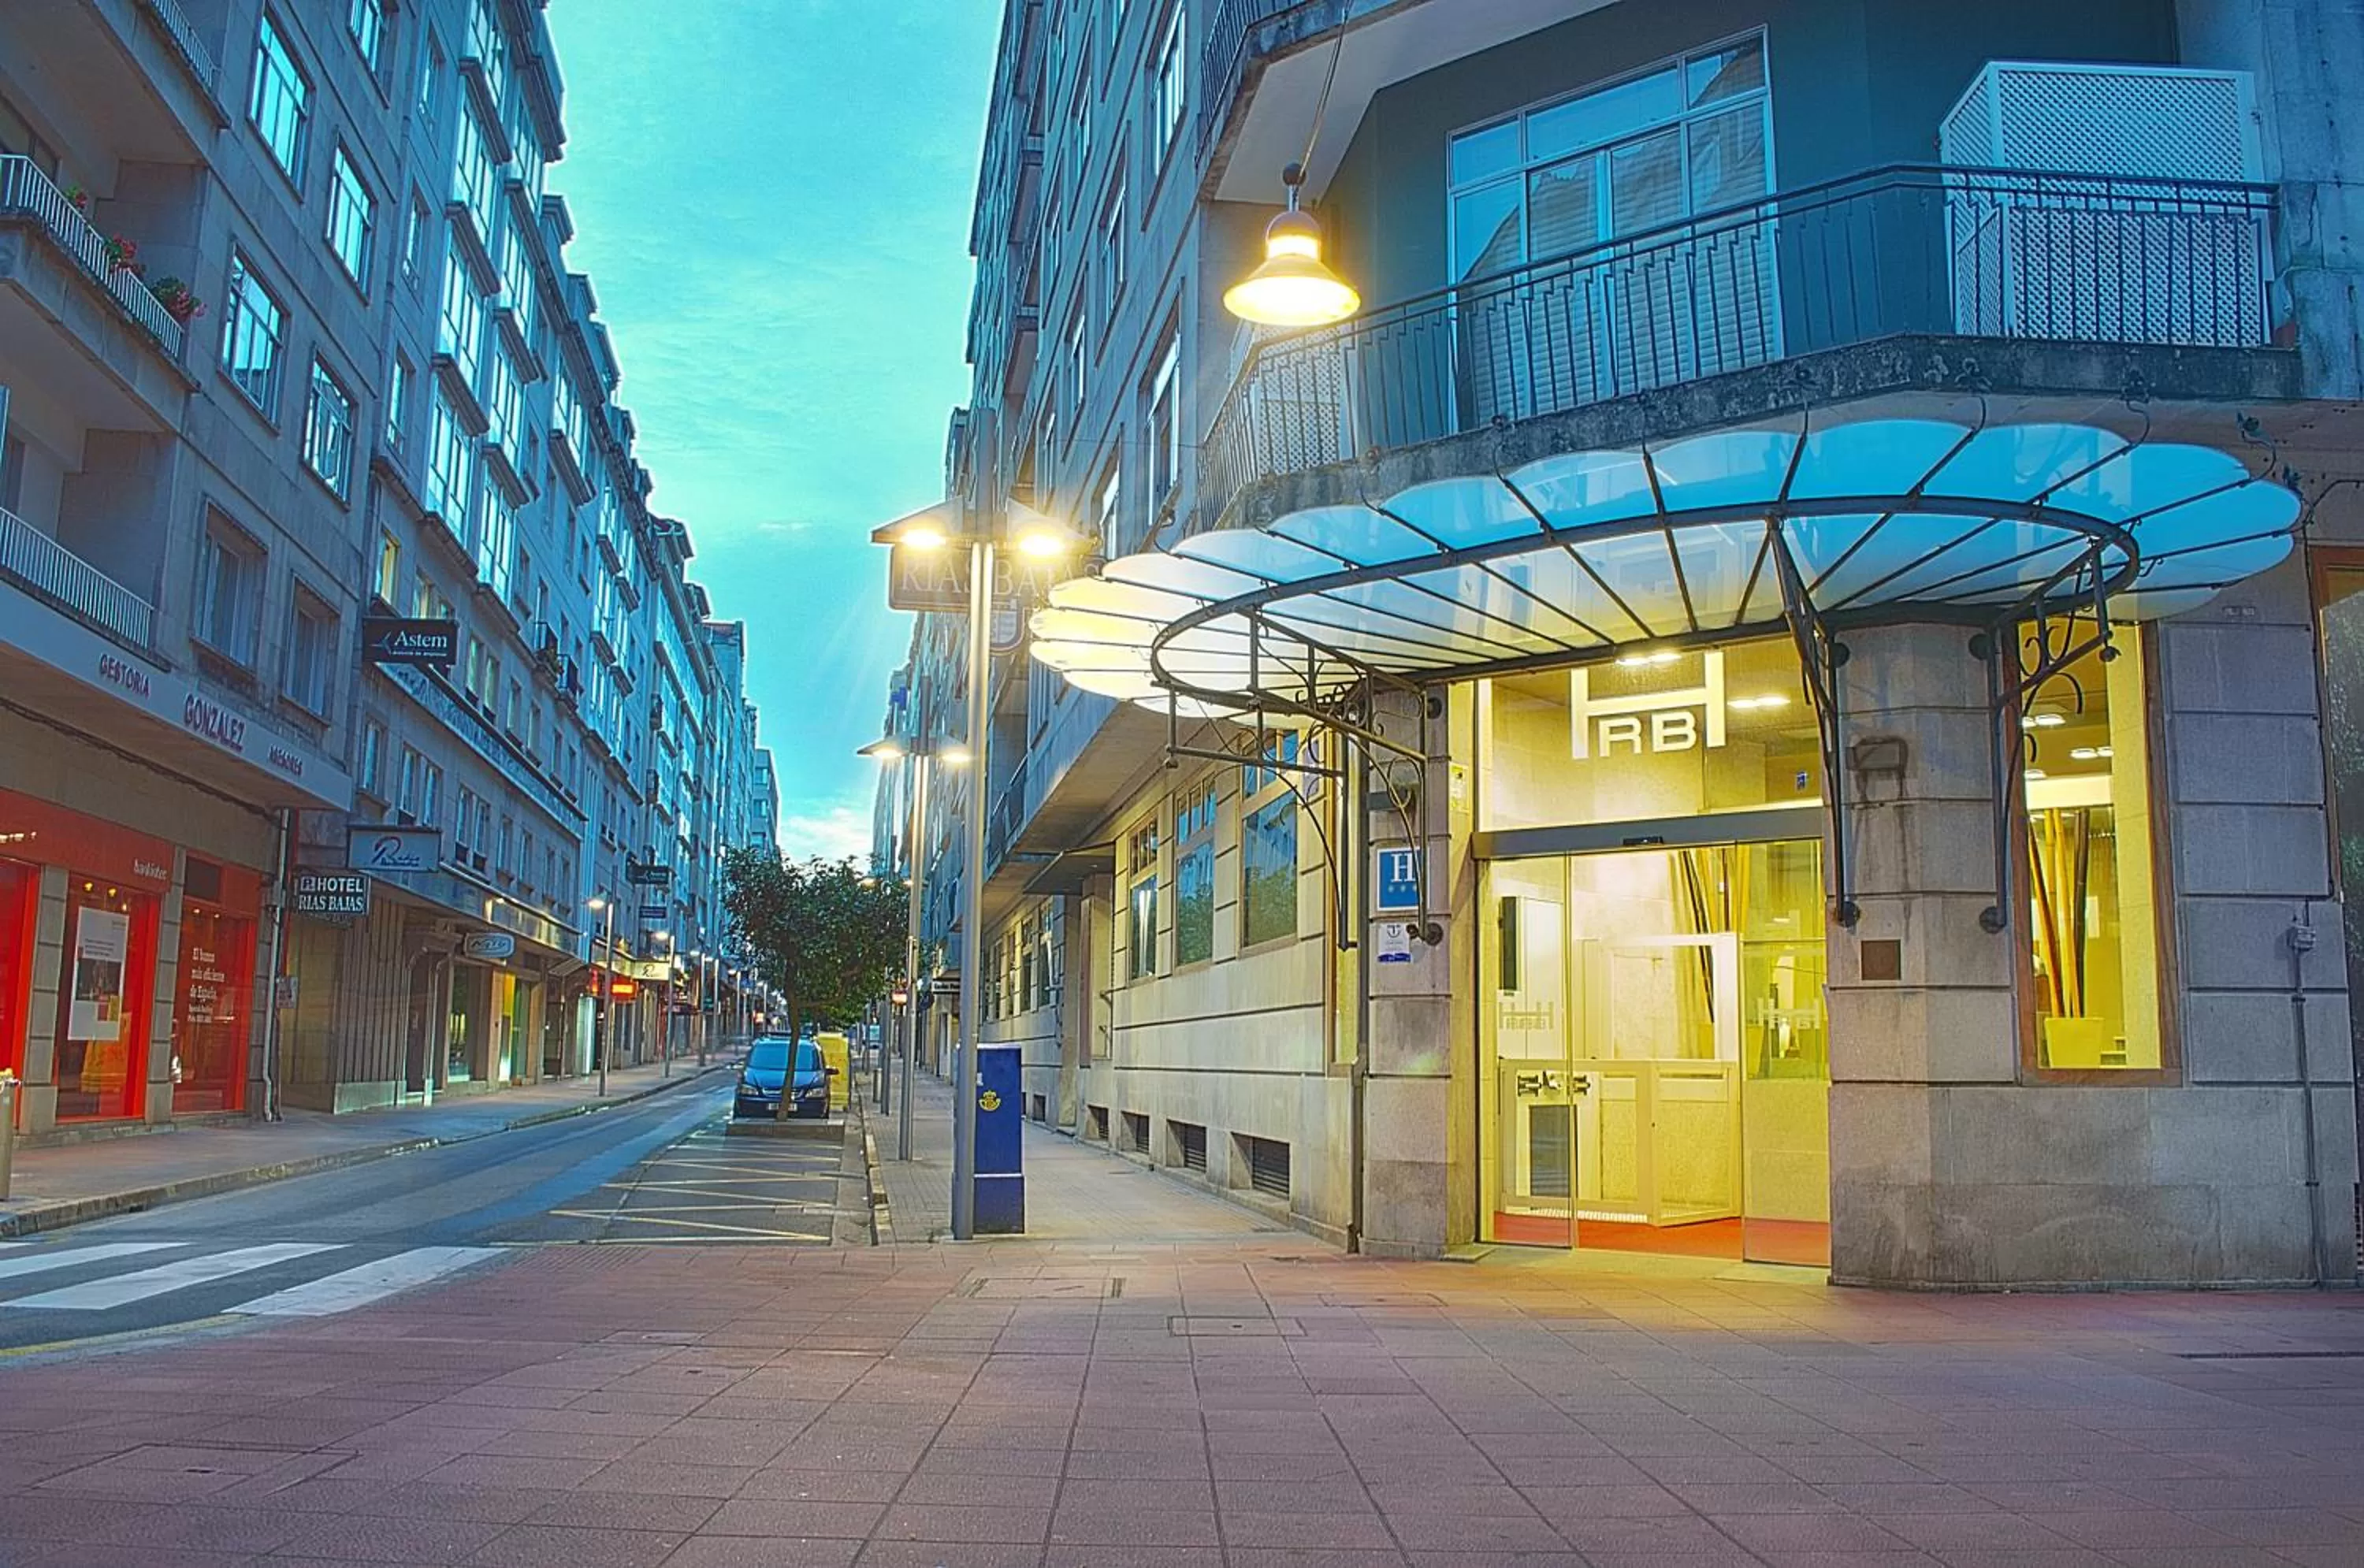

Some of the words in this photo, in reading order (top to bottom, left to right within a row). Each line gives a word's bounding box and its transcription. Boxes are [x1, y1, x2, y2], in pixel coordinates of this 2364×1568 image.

[394, 631, 447, 647] Astem
[100, 654, 149, 700] GESTORIA
[1391, 853, 1416, 882] H
[318, 877, 362, 892] HOTEL
[299, 895, 326, 910] RIAS
[329, 896, 363, 911] BAJAS
